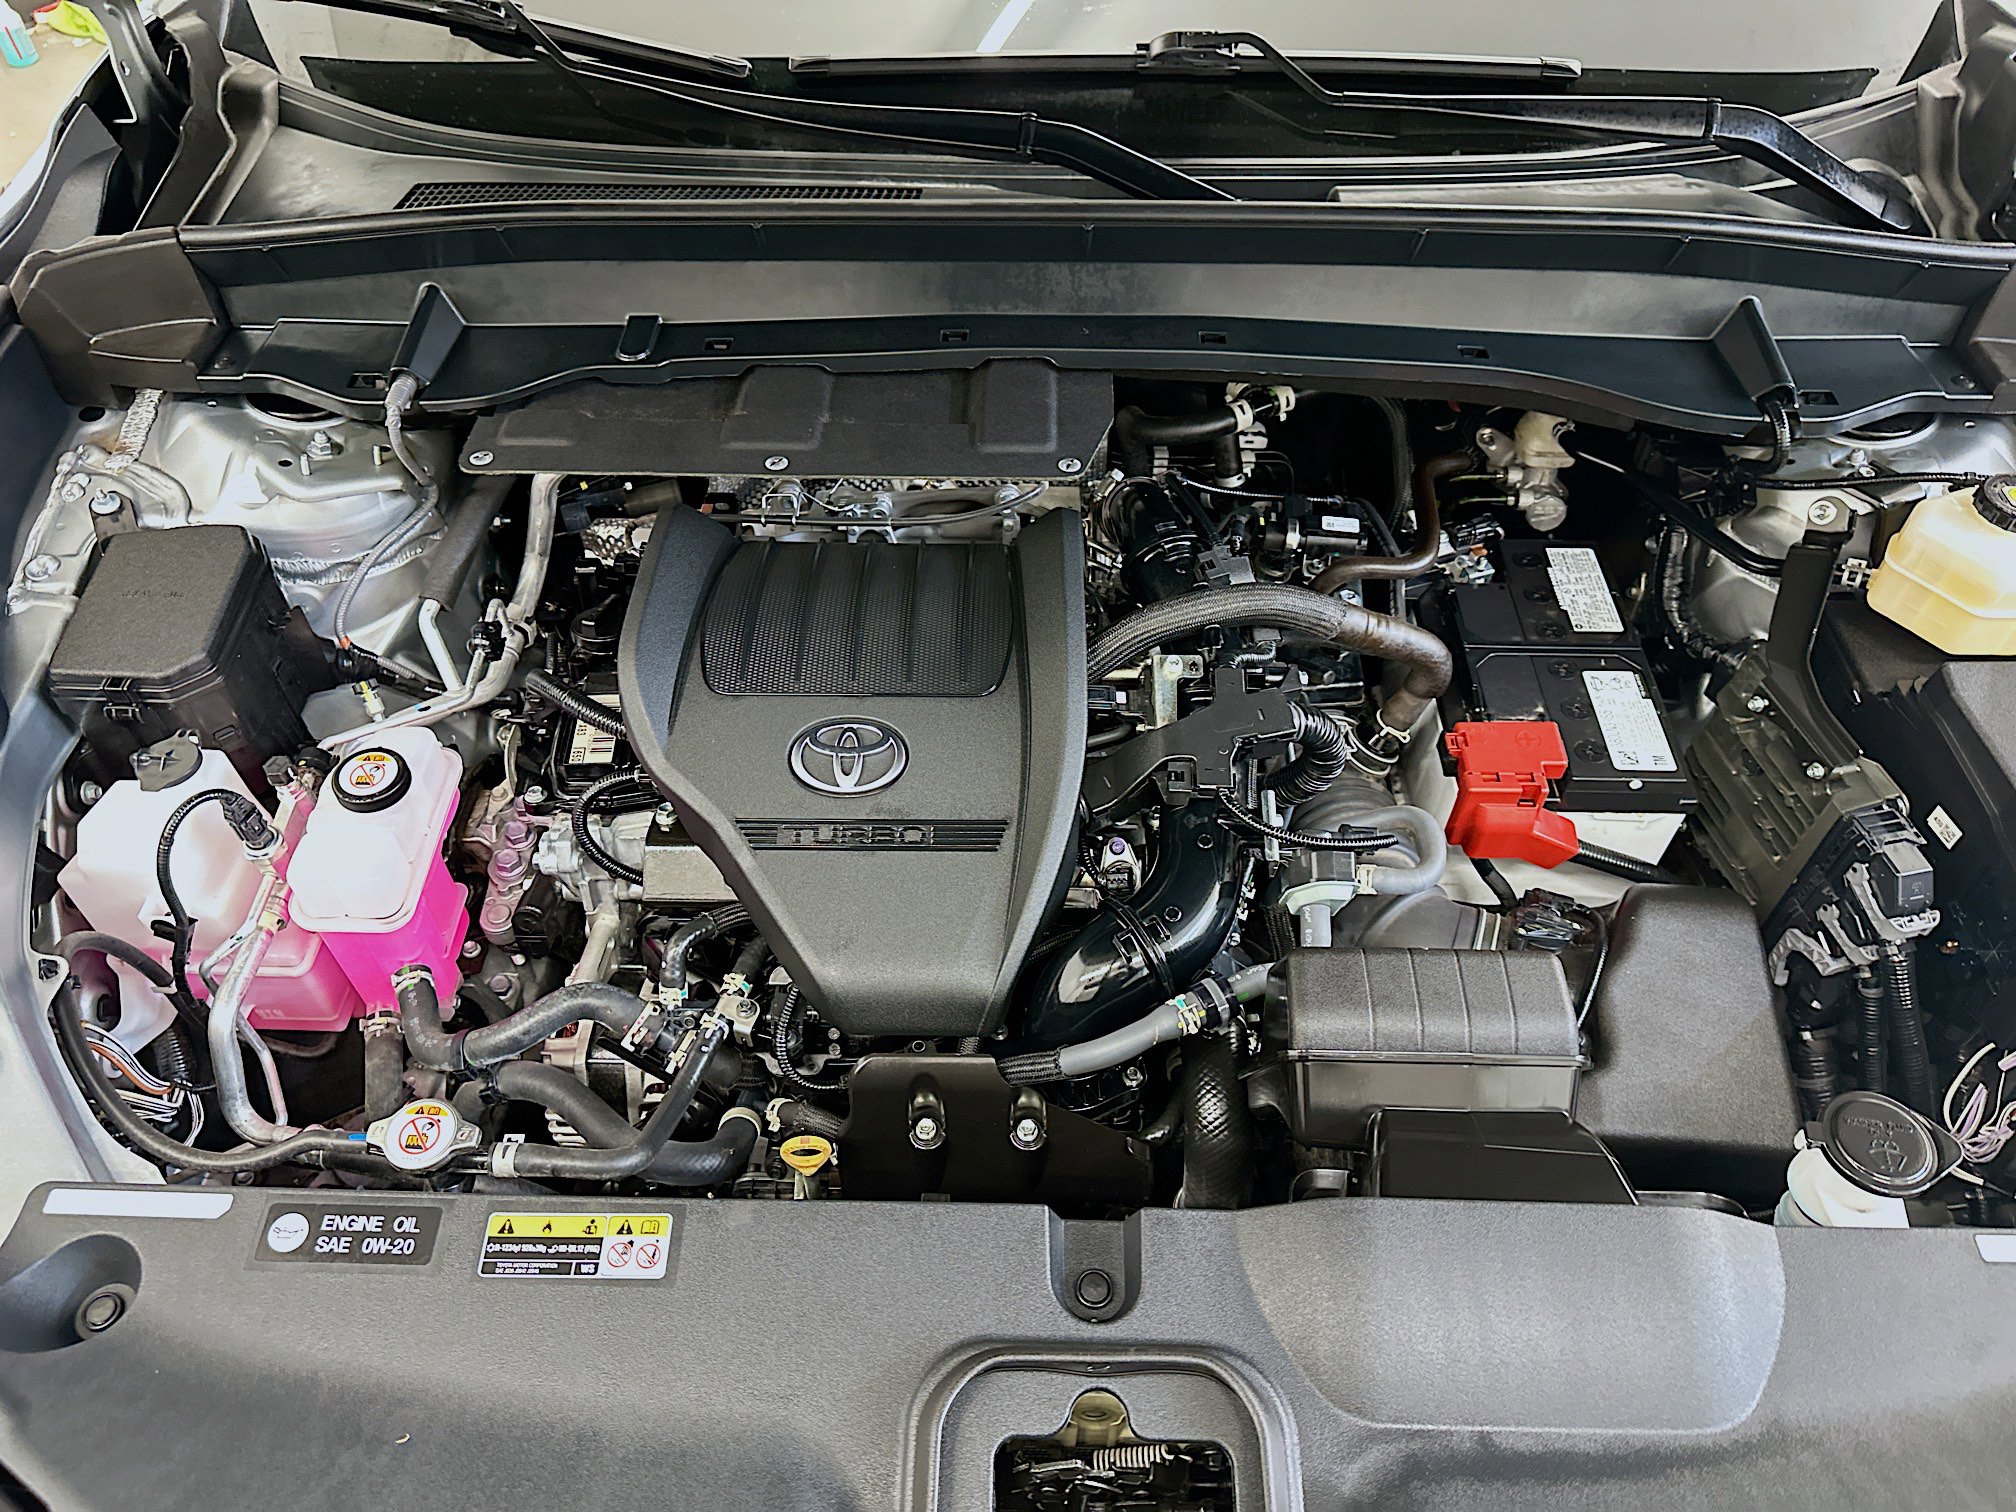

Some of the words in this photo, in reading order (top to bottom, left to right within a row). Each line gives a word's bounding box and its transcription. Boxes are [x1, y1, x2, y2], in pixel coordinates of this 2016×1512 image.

[780, 823, 928, 845] TURBO
[320, 1214, 385, 1233] ENGINE
[393, 1216, 421, 1234] OIL
[314, 1236, 353, 1254] SAE
[361, 1237, 416, 1256] 0W-20
